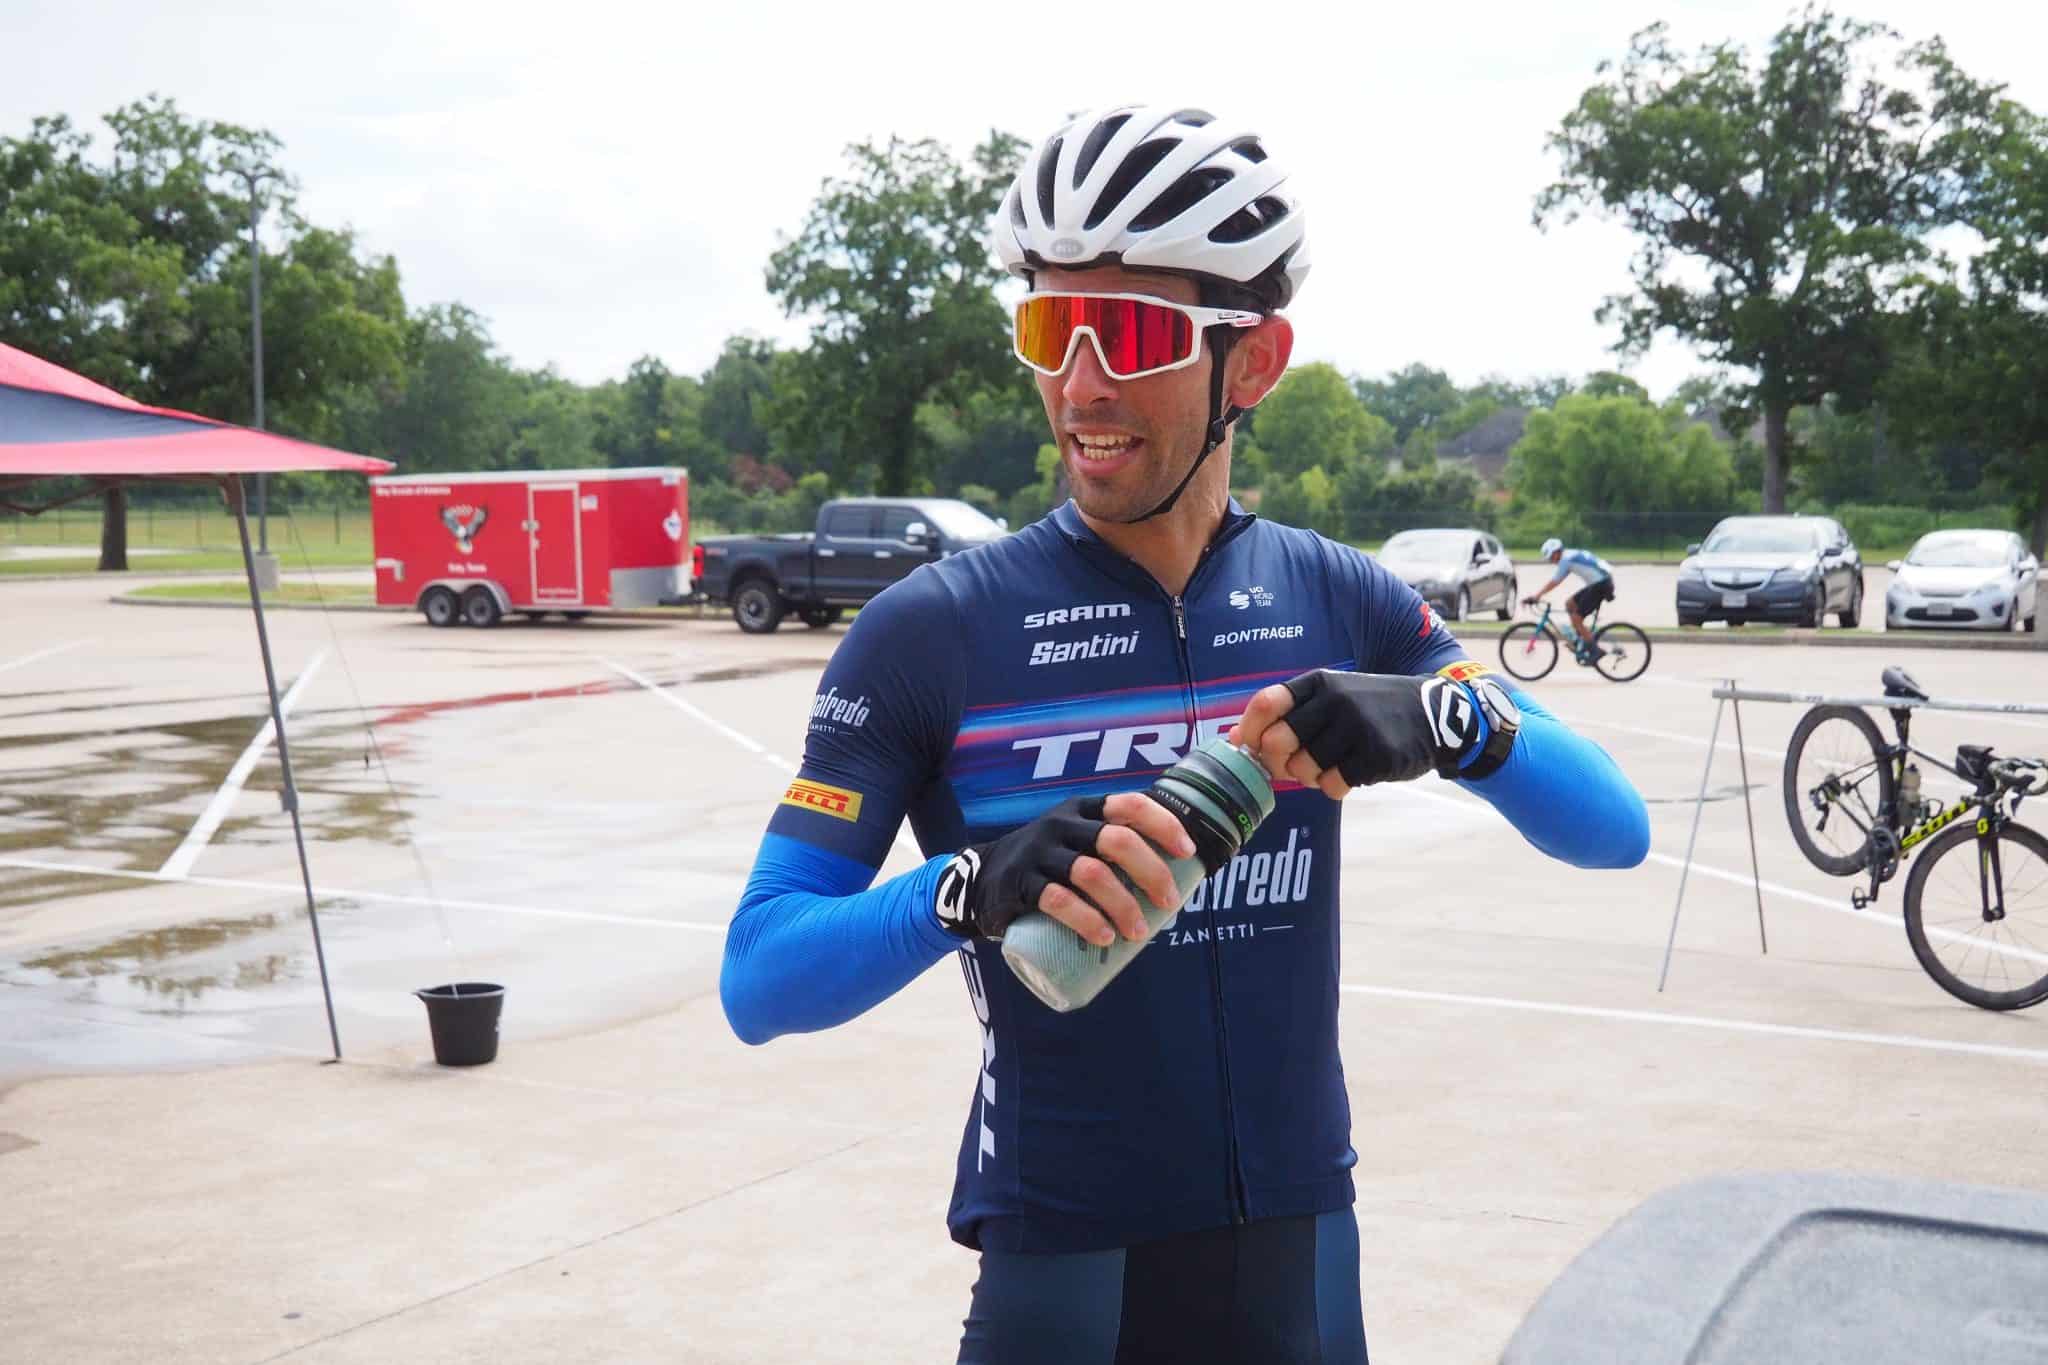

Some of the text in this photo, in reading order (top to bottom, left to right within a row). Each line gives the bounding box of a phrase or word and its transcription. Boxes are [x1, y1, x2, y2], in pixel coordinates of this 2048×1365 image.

[1023, 603, 1131, 629] SRAM
[1029, 630, 1140, 666] Santini
[1213, 625, 1304, 648] BONTRAGER
[1168, 923, 1255, 947] ZANETTI
